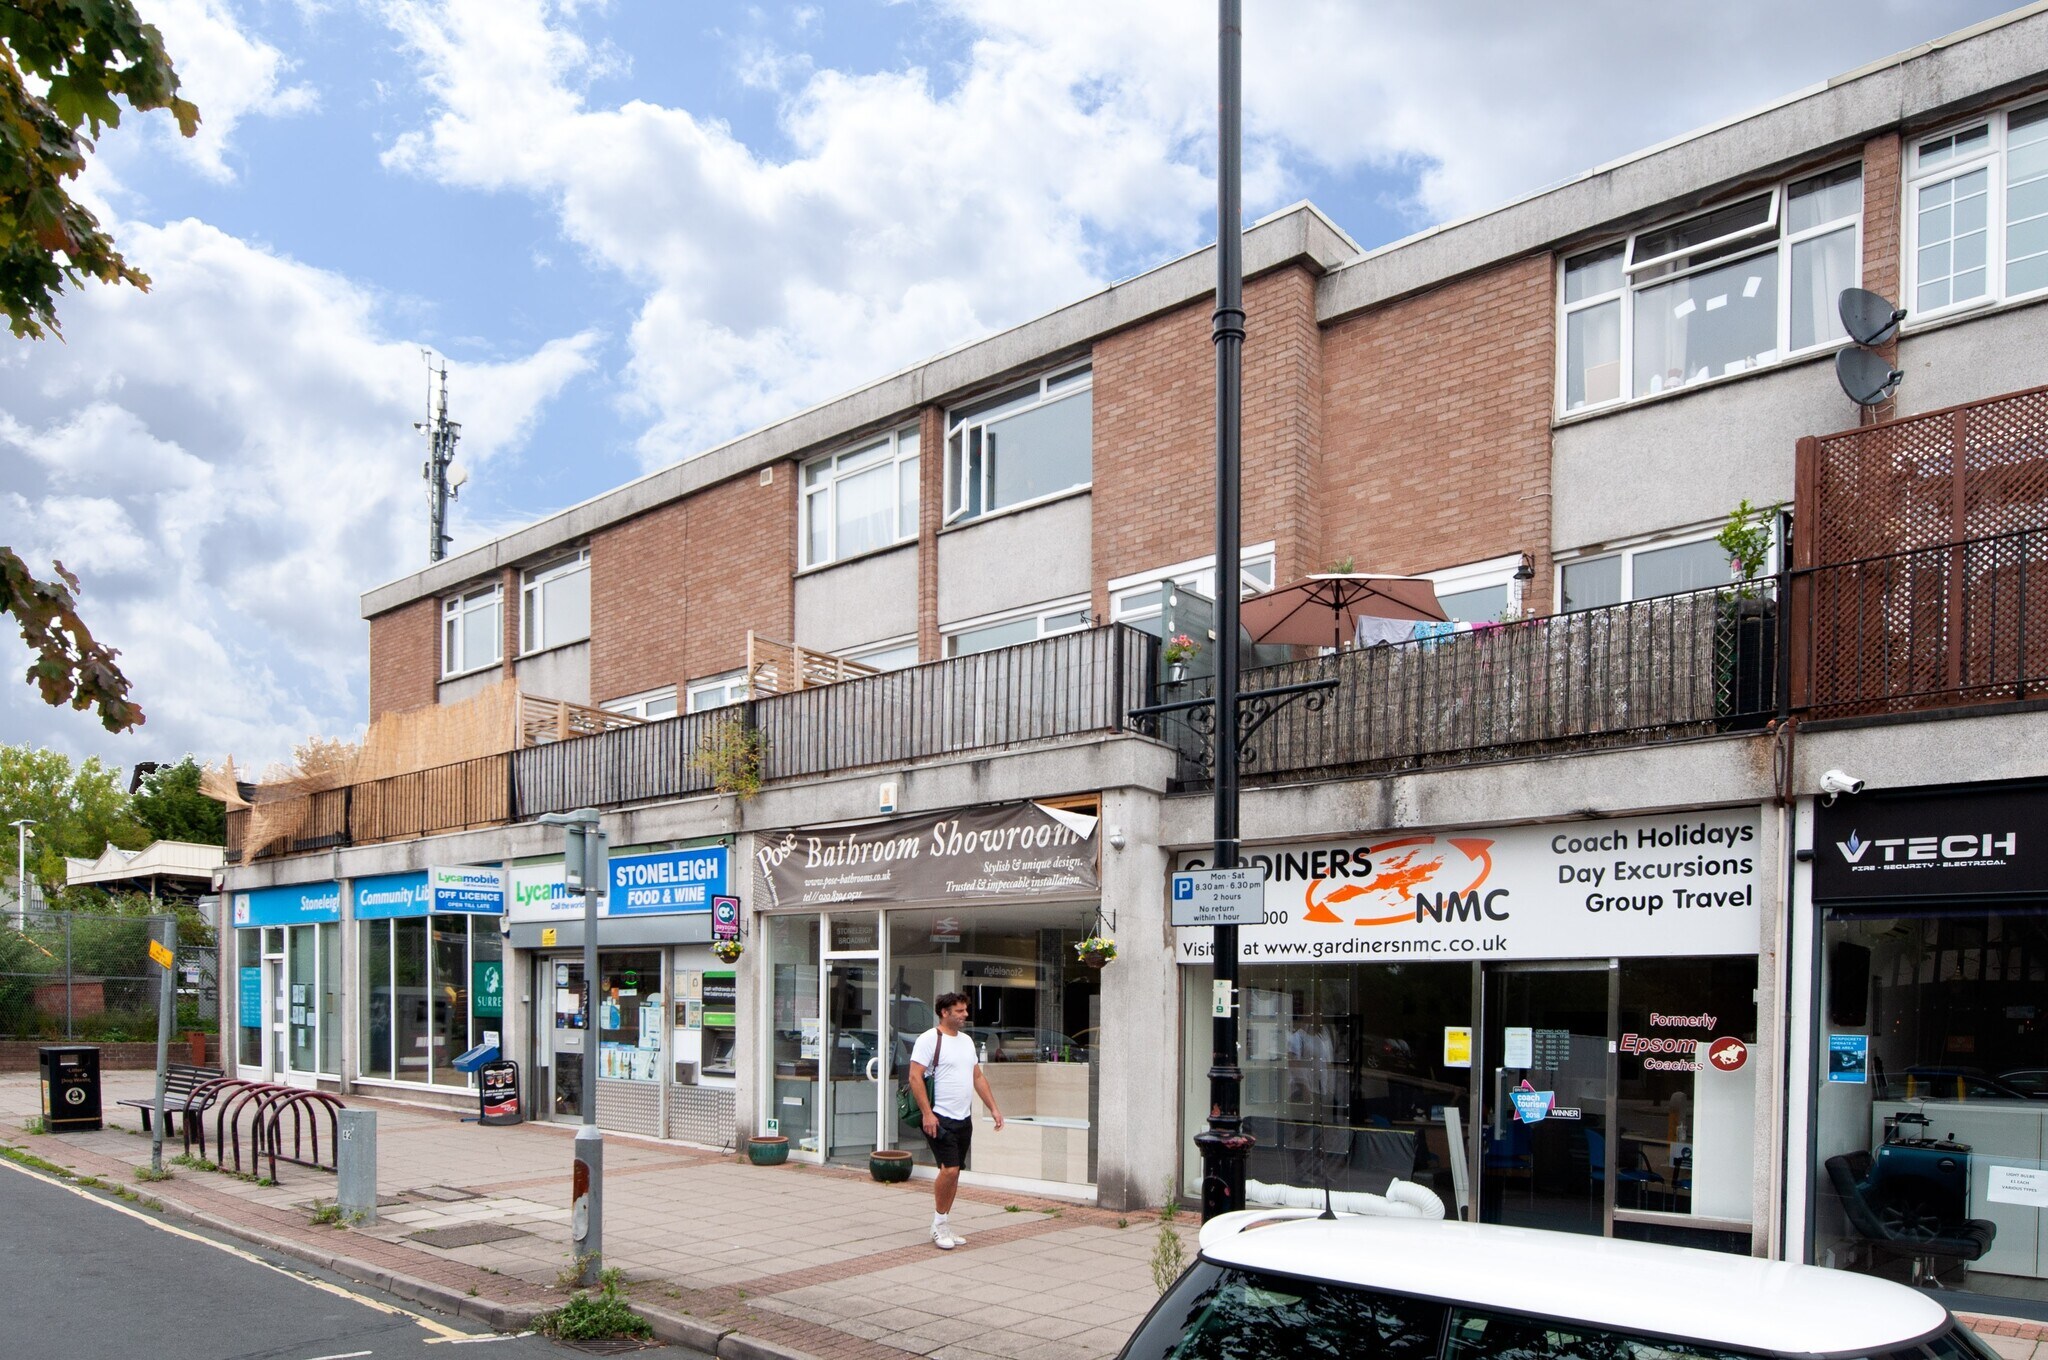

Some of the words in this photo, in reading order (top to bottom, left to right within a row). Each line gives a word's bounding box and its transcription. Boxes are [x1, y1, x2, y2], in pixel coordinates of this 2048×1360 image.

[805, 834, 920, 868] Bathroom
[930, 820, 1079, 857] Showroom
[1551, 830, 1628, 854] Coach
[1638, 822, 1754, 849] Holidays
[1836, 832, 2016, 863] VTECH
[756, 833, 798, 878] Pose
[1943, 860, 2006, 868] ELECTRICAL
[616, 858, 718, 887] STONELEIGH
[984, 860, 1011, 876] Stylish
[1012, 859, 1022, 871] &
[1022, 860, 1052, 874] unique
[1053, 856, 1083, 870] design.
[1232, 872, 1245, 880] Sat
[1559, 865, 1605, 887] Day
[1615, 855, 1753, 881] Excursions
[438, 872, 500, 885] Lycamobile
[946, 880, 976, 893] Trusted
[977, 879, 987, 890] &
[987, 877, 1030, 893] impeccable
[1031, 874, 1082, 887] installation.
[1196, 883, 1213, 891] 8.30
[360, 887, 414, 907] Community
[438, 891, 457, 899] OFF
[459, 892, 500, 902] LICENCE
[628, 890, 660, 906] FOOD
[662, 889, 671, 904] &
[674, 886, 705, 902] WINE
[1416, 889, 1510, 923] NMC
[1586, 893, 1664, 916] Group
[1673, 884, 1752, 909] Travel
[1194, 913, 1215, 921] within
[1223, 912, 1240, 920] hour
[837, 927, 872, 935] STONELEIGH
[839, 937, 871, 945] BROADWAY
[1244, 942, 1259, 955] at
[1264, 935, 1507, 957] www.gardinersnmc.co.uk
[1650, 1013, 1717, 1030] Formerly
[1620, 1033, 1698, 1056] Epsom
[1644, 1058, 1704, 1072] Coaches
